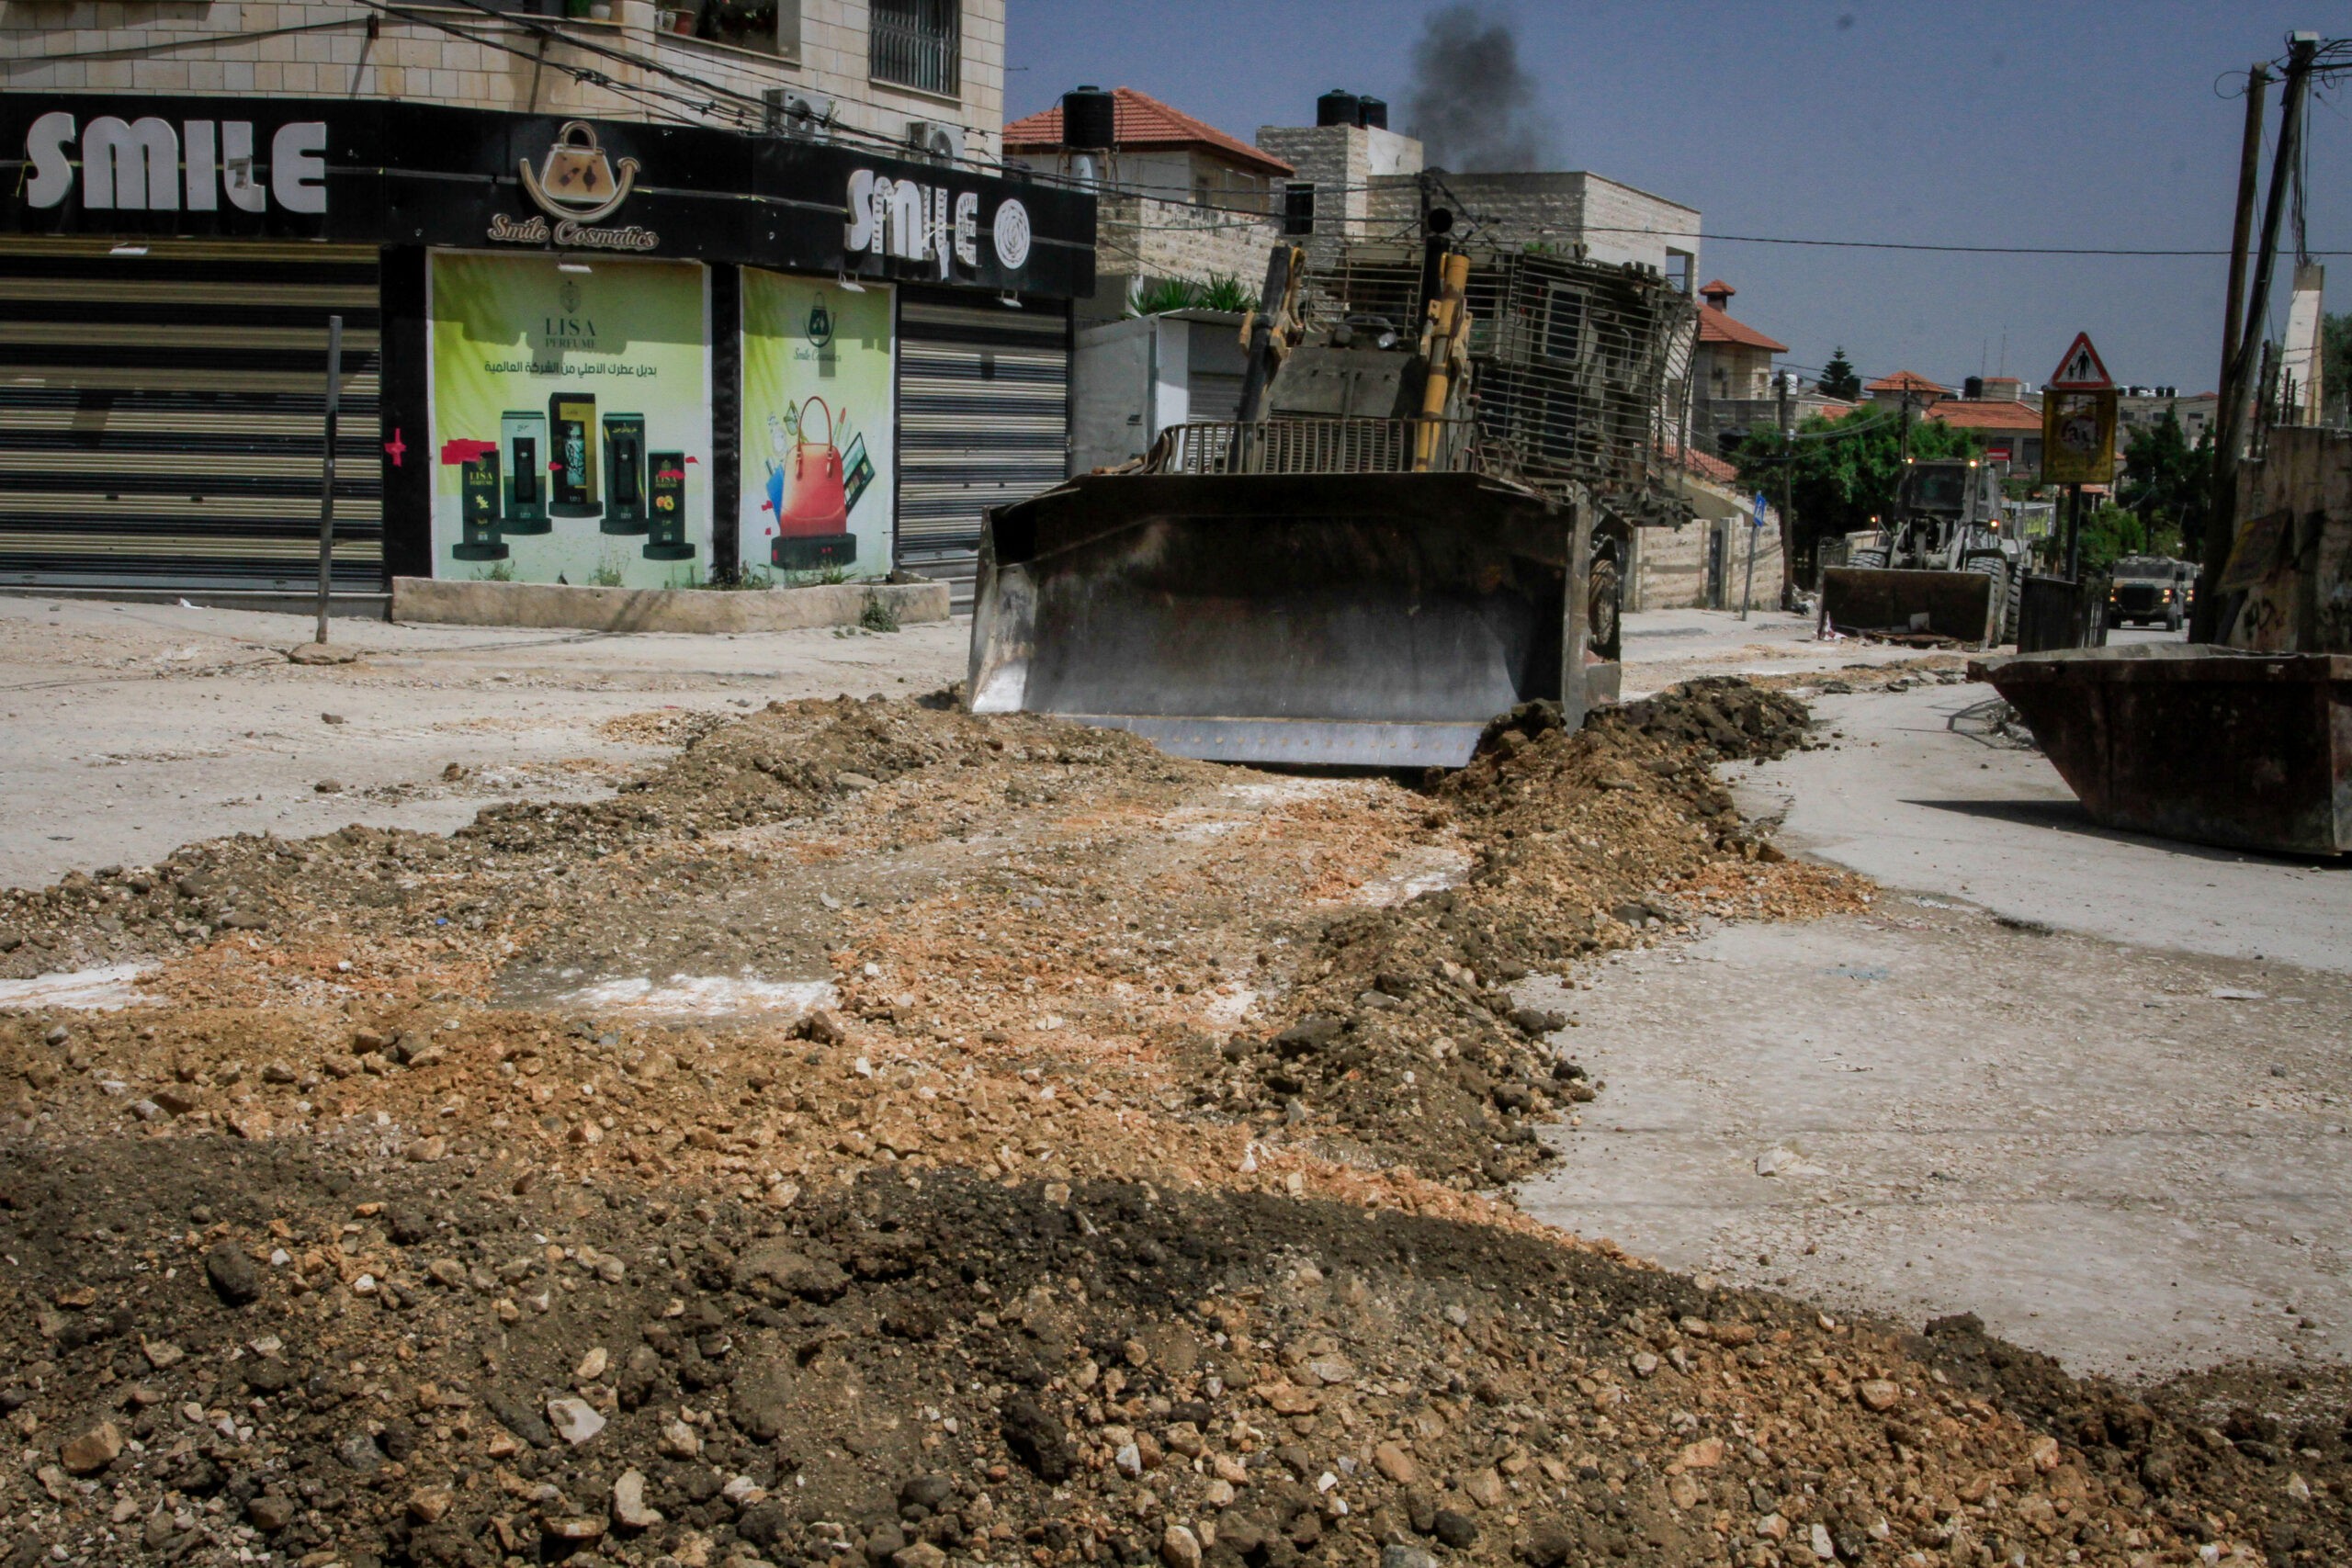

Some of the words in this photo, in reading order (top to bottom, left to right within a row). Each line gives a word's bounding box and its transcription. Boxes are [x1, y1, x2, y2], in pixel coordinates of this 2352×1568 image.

[27, 111, 327, 213] SMILE
[487, 213, 550, 243] Smile
[554, 220, 660, 251] Cosmatics
[545, 317, 596, 336] LISA
[545, 338, 595, 349] PERFUME
[484, 360, 523, 374] العالمية
[525, 360, 559, 375] الشركة
[560, 362, 576, 376] من
[607, 363, 635, 377] عطرك
[637, 363, 657, 378] بديل
